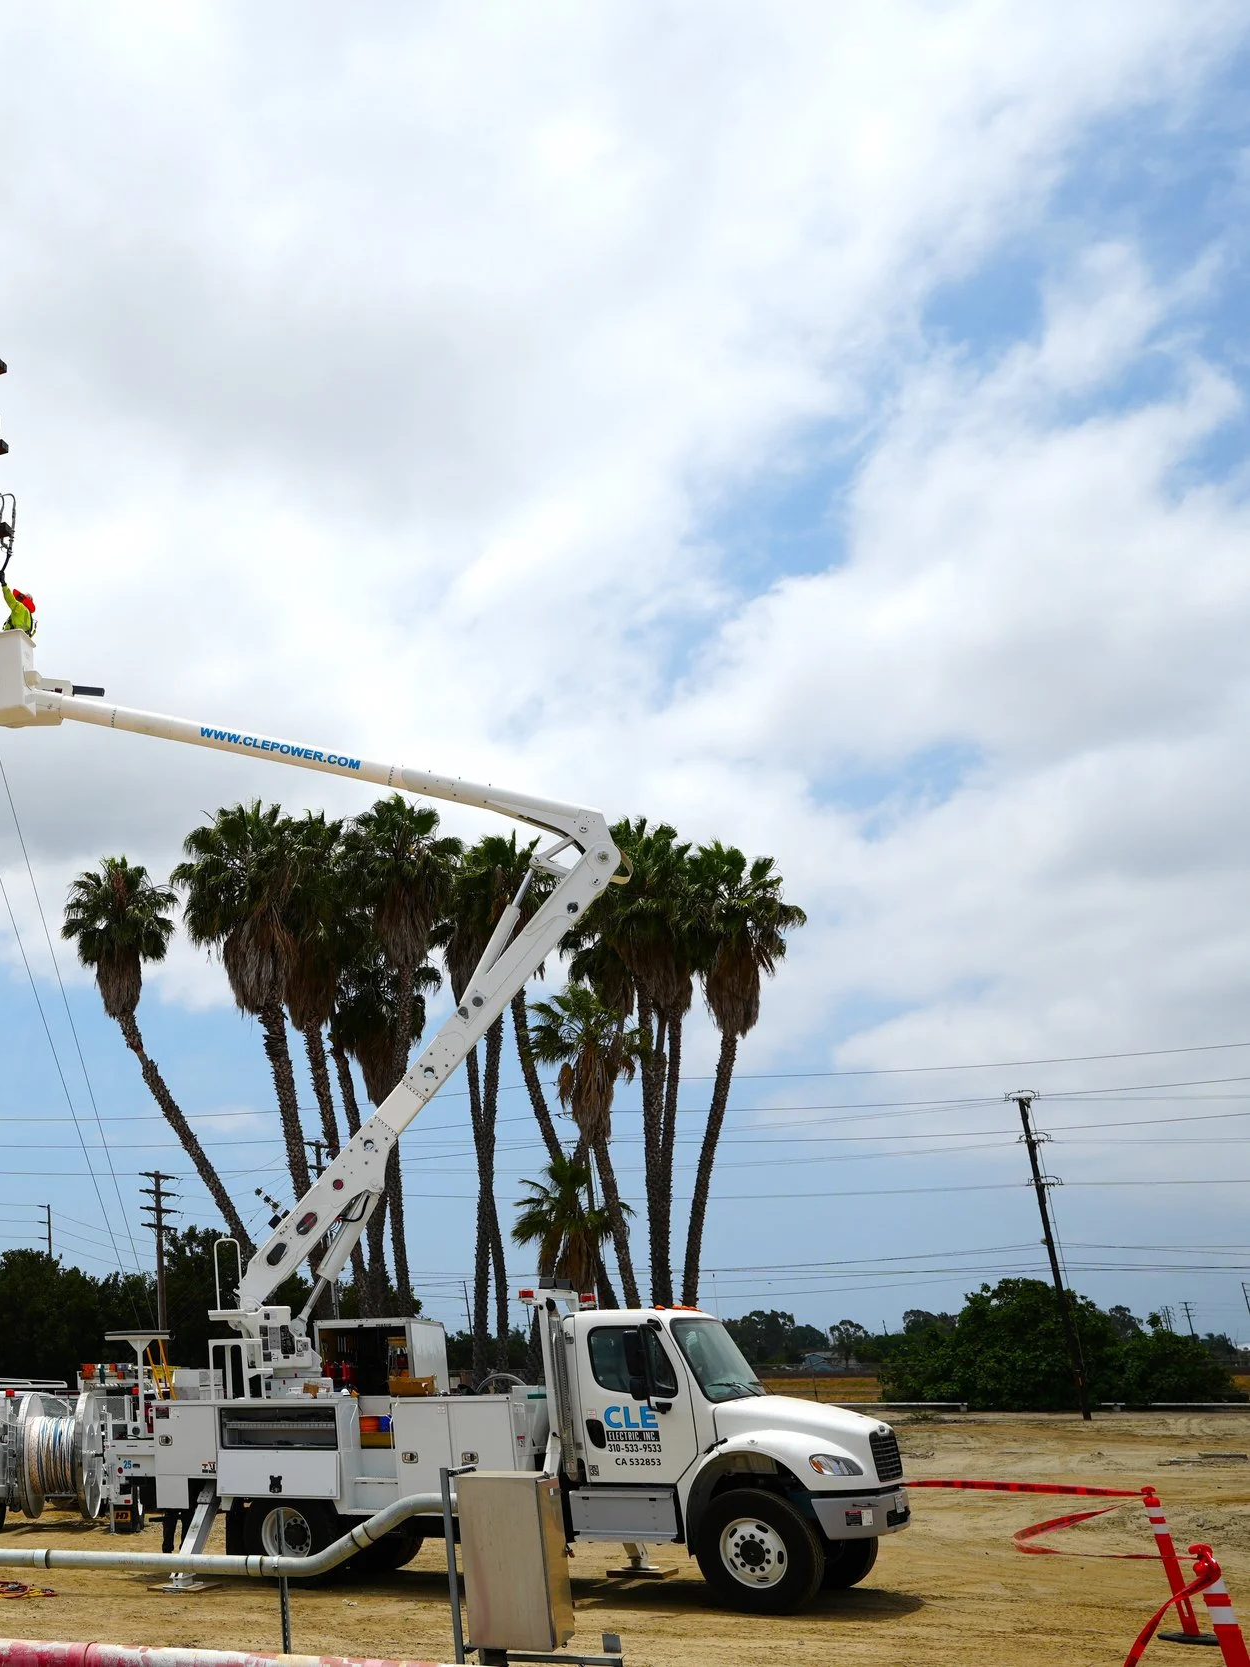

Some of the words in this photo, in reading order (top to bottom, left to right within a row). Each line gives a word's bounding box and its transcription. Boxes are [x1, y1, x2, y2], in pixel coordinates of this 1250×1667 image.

[200, 727, 361, 770] WWW.CLEPOWER.COM
[604, 1406, 659, 1428] CLE
[643, 1431, 658, 1441] INC.
[607, 1443, 662, 1453] 310-533-9533
[123, 1459, 132, 1469] 25
[615, 1457, 628, 1466] CA
[629, 1457, 662, 1466] 532853
